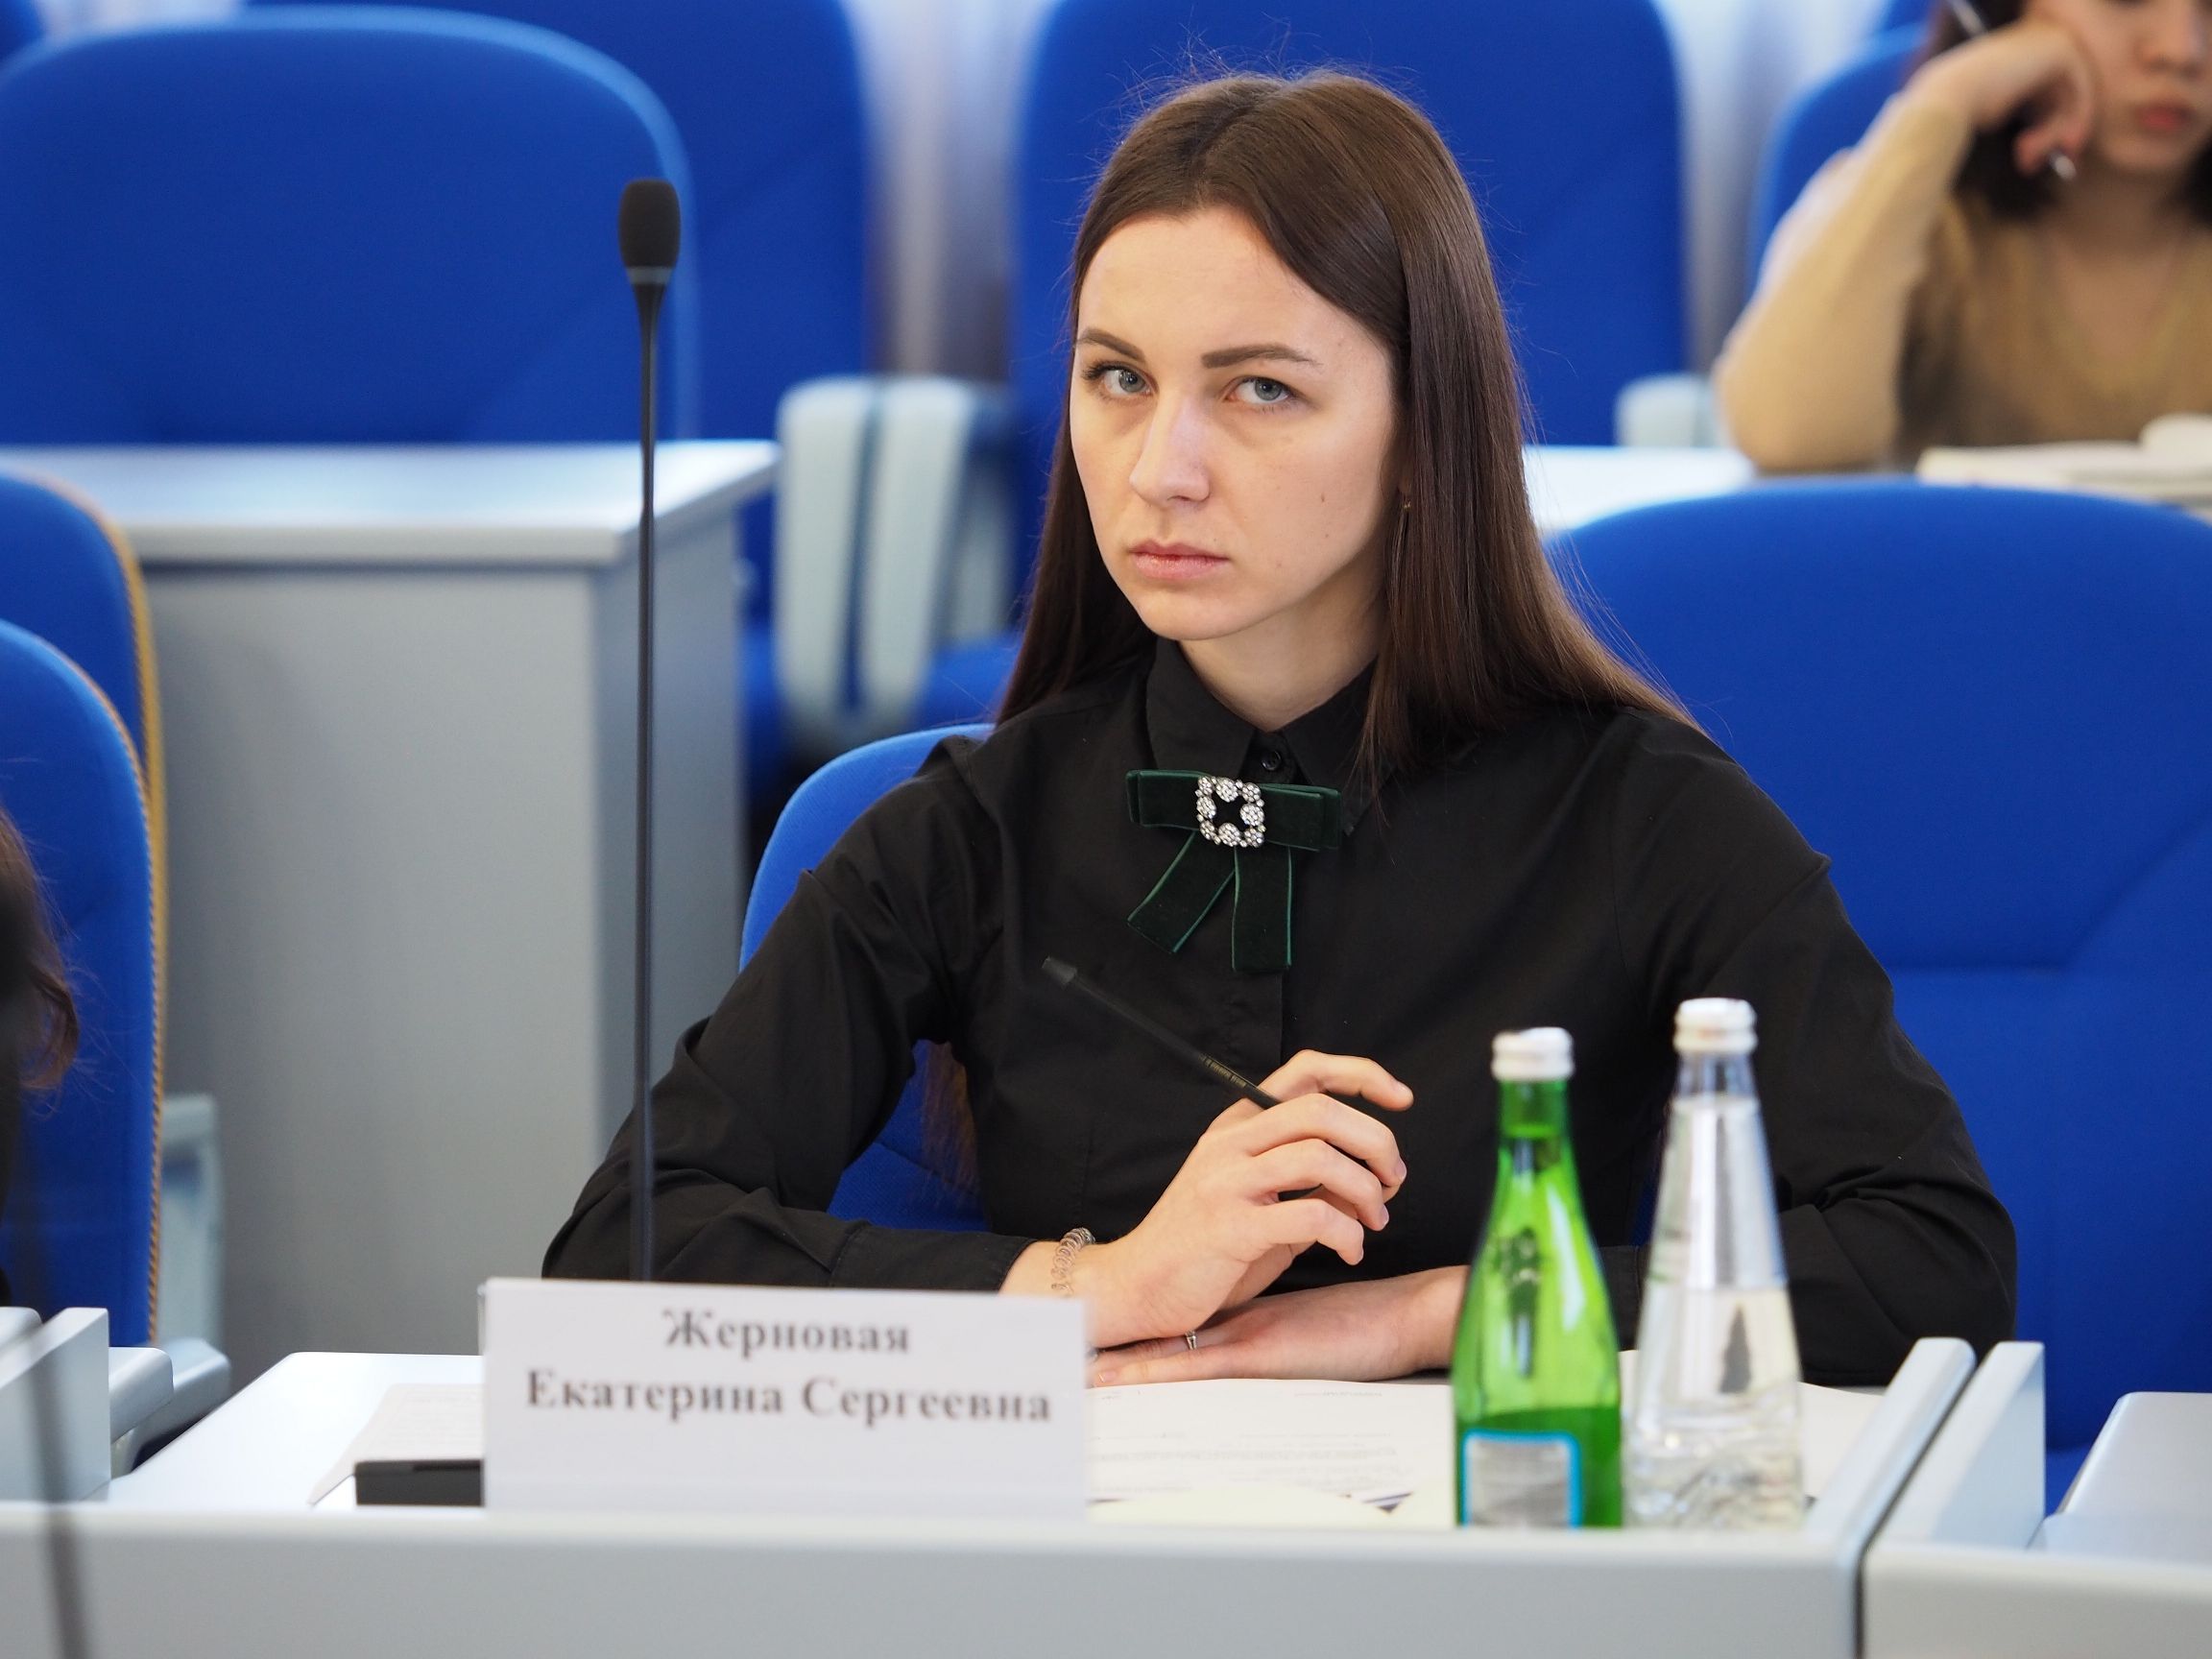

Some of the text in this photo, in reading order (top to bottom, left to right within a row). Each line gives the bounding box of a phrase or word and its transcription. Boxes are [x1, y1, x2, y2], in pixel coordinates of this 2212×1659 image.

[663, 1309, 910, 1358] Жерновая
[526, 1369, 1051, 1428] Екатерина Сергеевна
